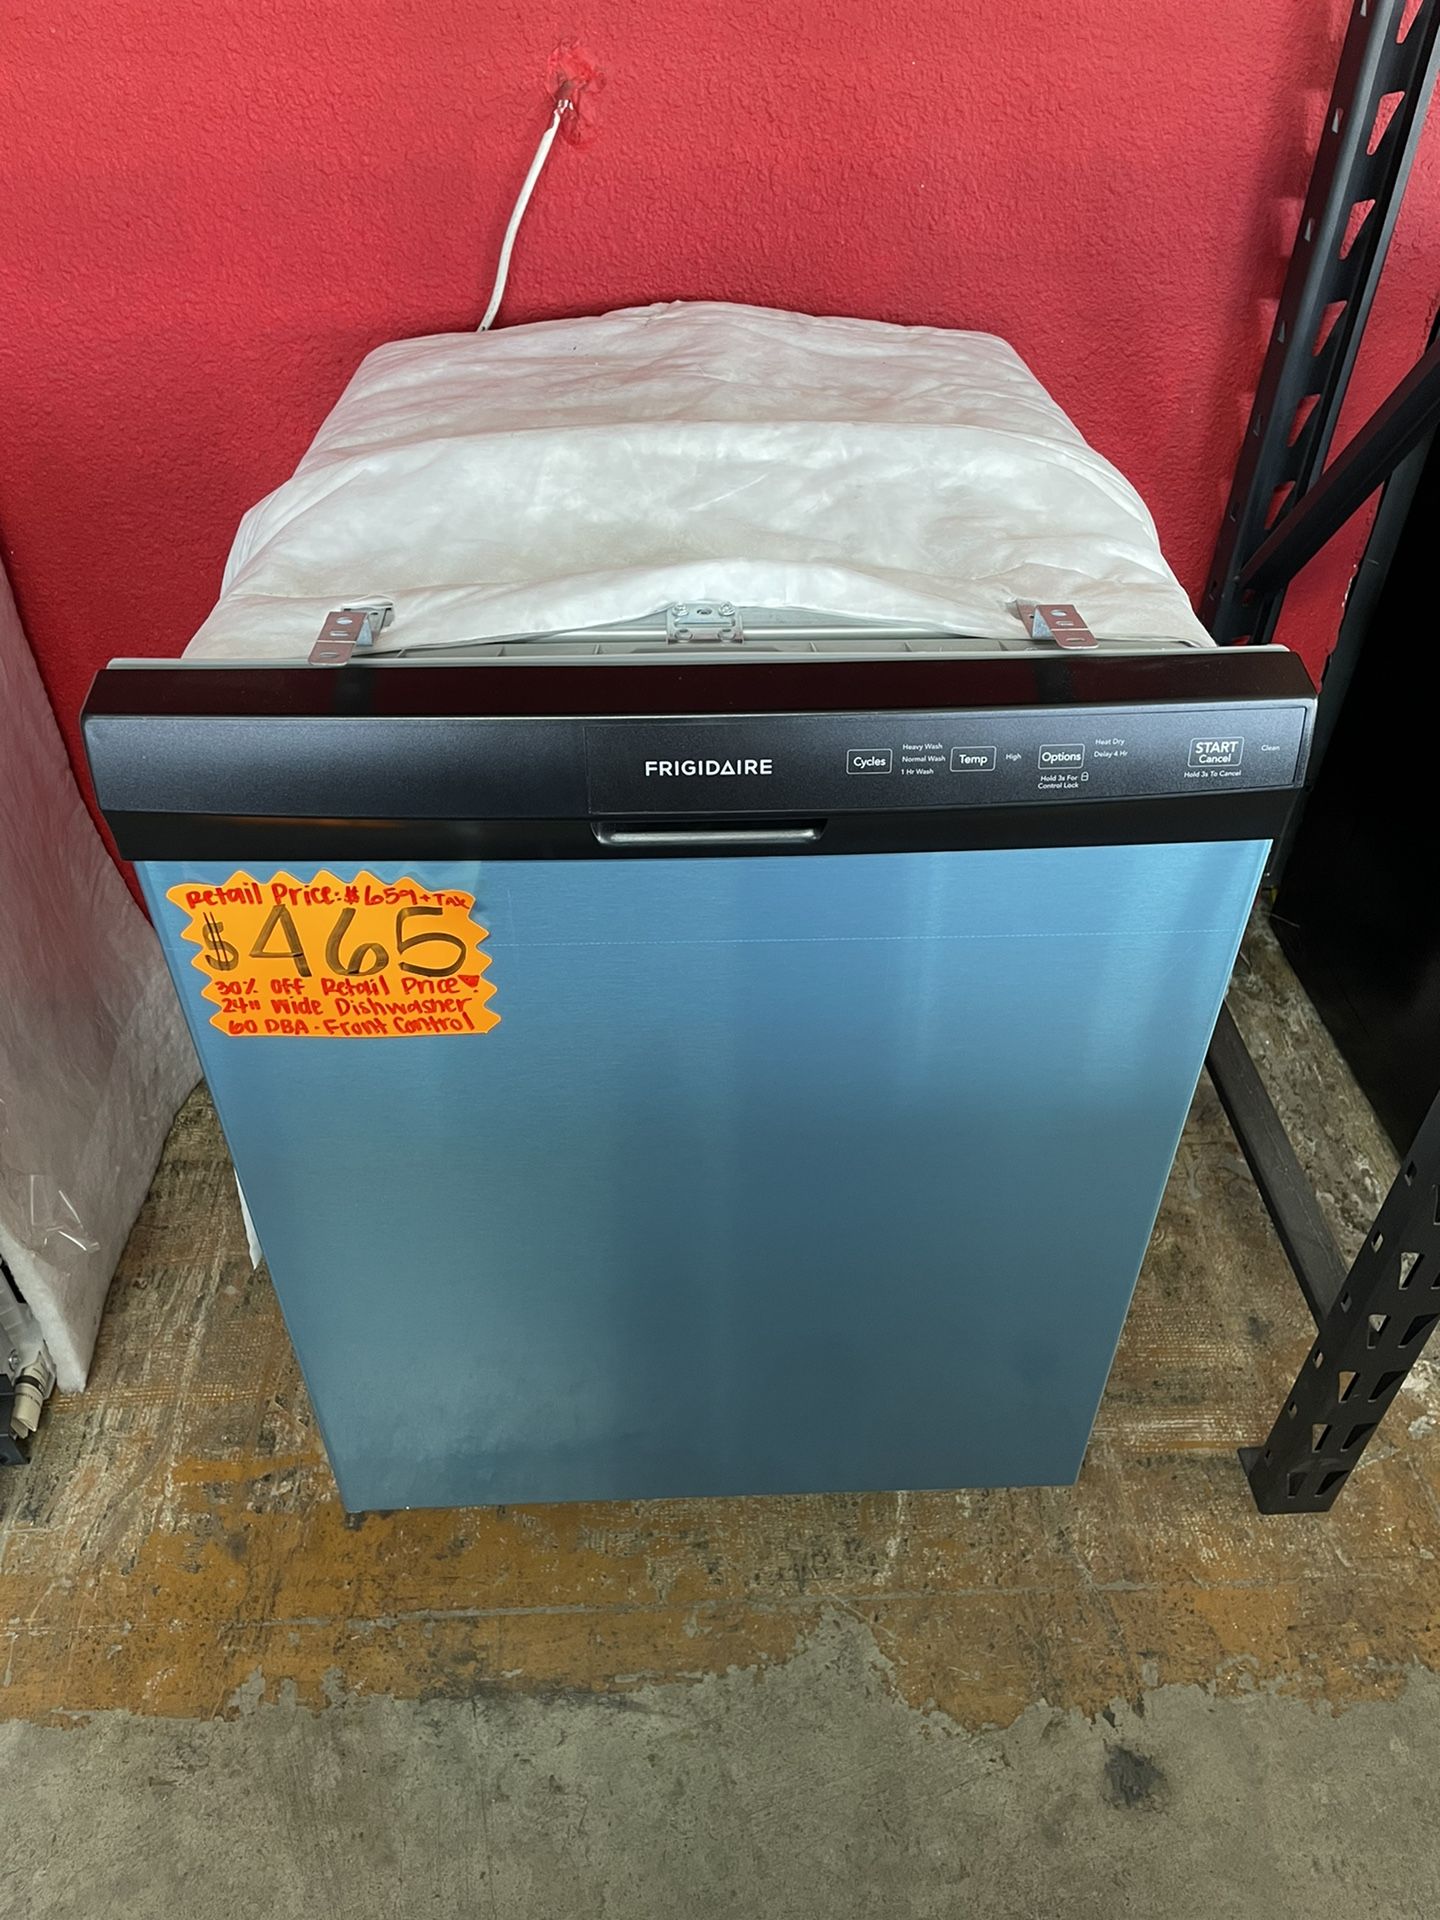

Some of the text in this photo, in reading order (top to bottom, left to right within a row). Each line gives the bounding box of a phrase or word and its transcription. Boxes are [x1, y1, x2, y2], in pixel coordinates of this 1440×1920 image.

[902, 742, 943, 751] Heavy Wash
[1095, 737, 1126, 746] Heat Dry
[1195, 741, 1239, 754] START
[1260, 744, 1281, 752] Clean
[901, 754, 946, 763] Normal Wash
[959, 753, 988, 766] Temp
[1005, 753, 1022, 761] High
[1041, 751, 1082, 764] Options
[1093, 750, 1113, 759] Delay
[1198, 753, 1232, 764] Cancel
[645, 758, 773, 777] FRIGIDAIRE
[853, 756, 887, 769] Cycles
[915, 767, 934, 775] Wash
[1183, 770, 1200, 778] Hold
[1209, 770, 1218, 778] To
[1218, 769, 1242, 777] Cancel
[1066, 774, 1078, 782] For
[1037, 781, 1079, 790] Control Lock
[202, 904, 467, 977] $465
[214, 977, 259, 996] 30%
[320, 974, 391, 997] Retail
[270, 996, 324, 1016] Wide
[334, 997, 473, 1017] Dishwasher
[228, 1019, 258, 1035] 60
[263, 1018, 310, 1036] DBA
[322, 1017, 388, 1037] Front
[392, 1011, 476, 1034] Control
